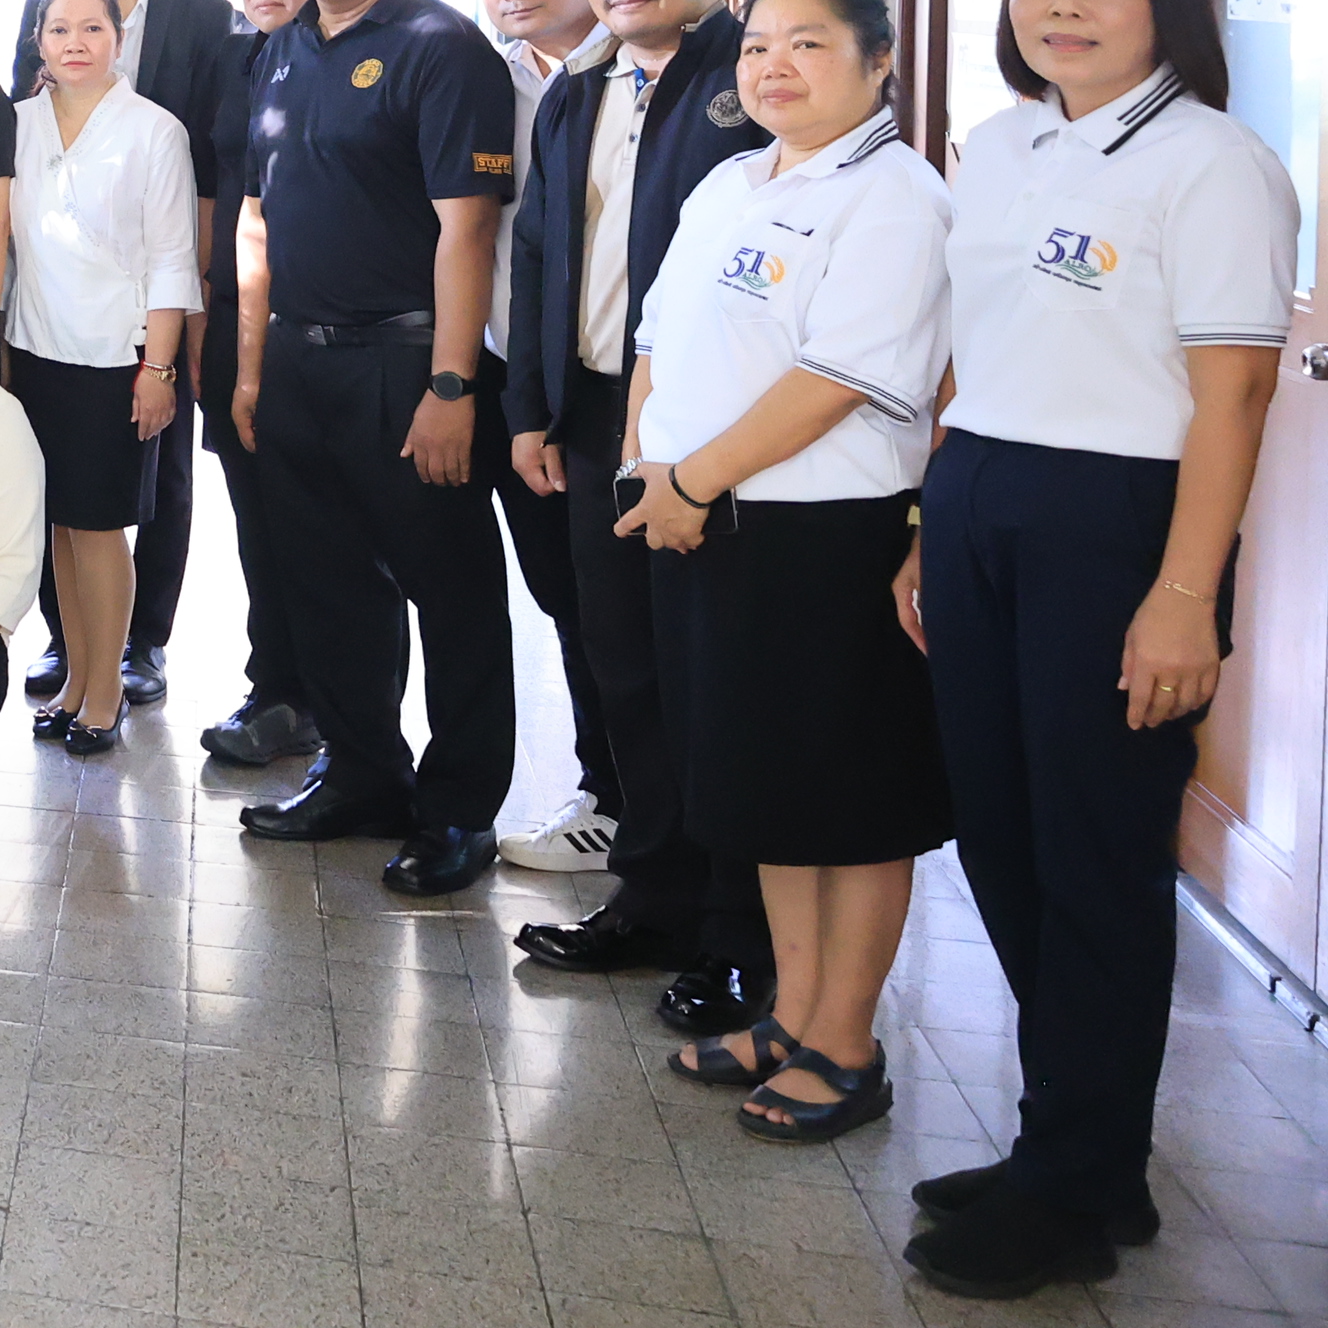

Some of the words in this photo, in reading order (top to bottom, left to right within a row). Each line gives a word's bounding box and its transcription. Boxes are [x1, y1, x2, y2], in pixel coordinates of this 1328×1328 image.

[477, 156, 510, 169] STAFF
[1037, 227, 1092, 264] 51
[723, 246, 766, 278] 51
